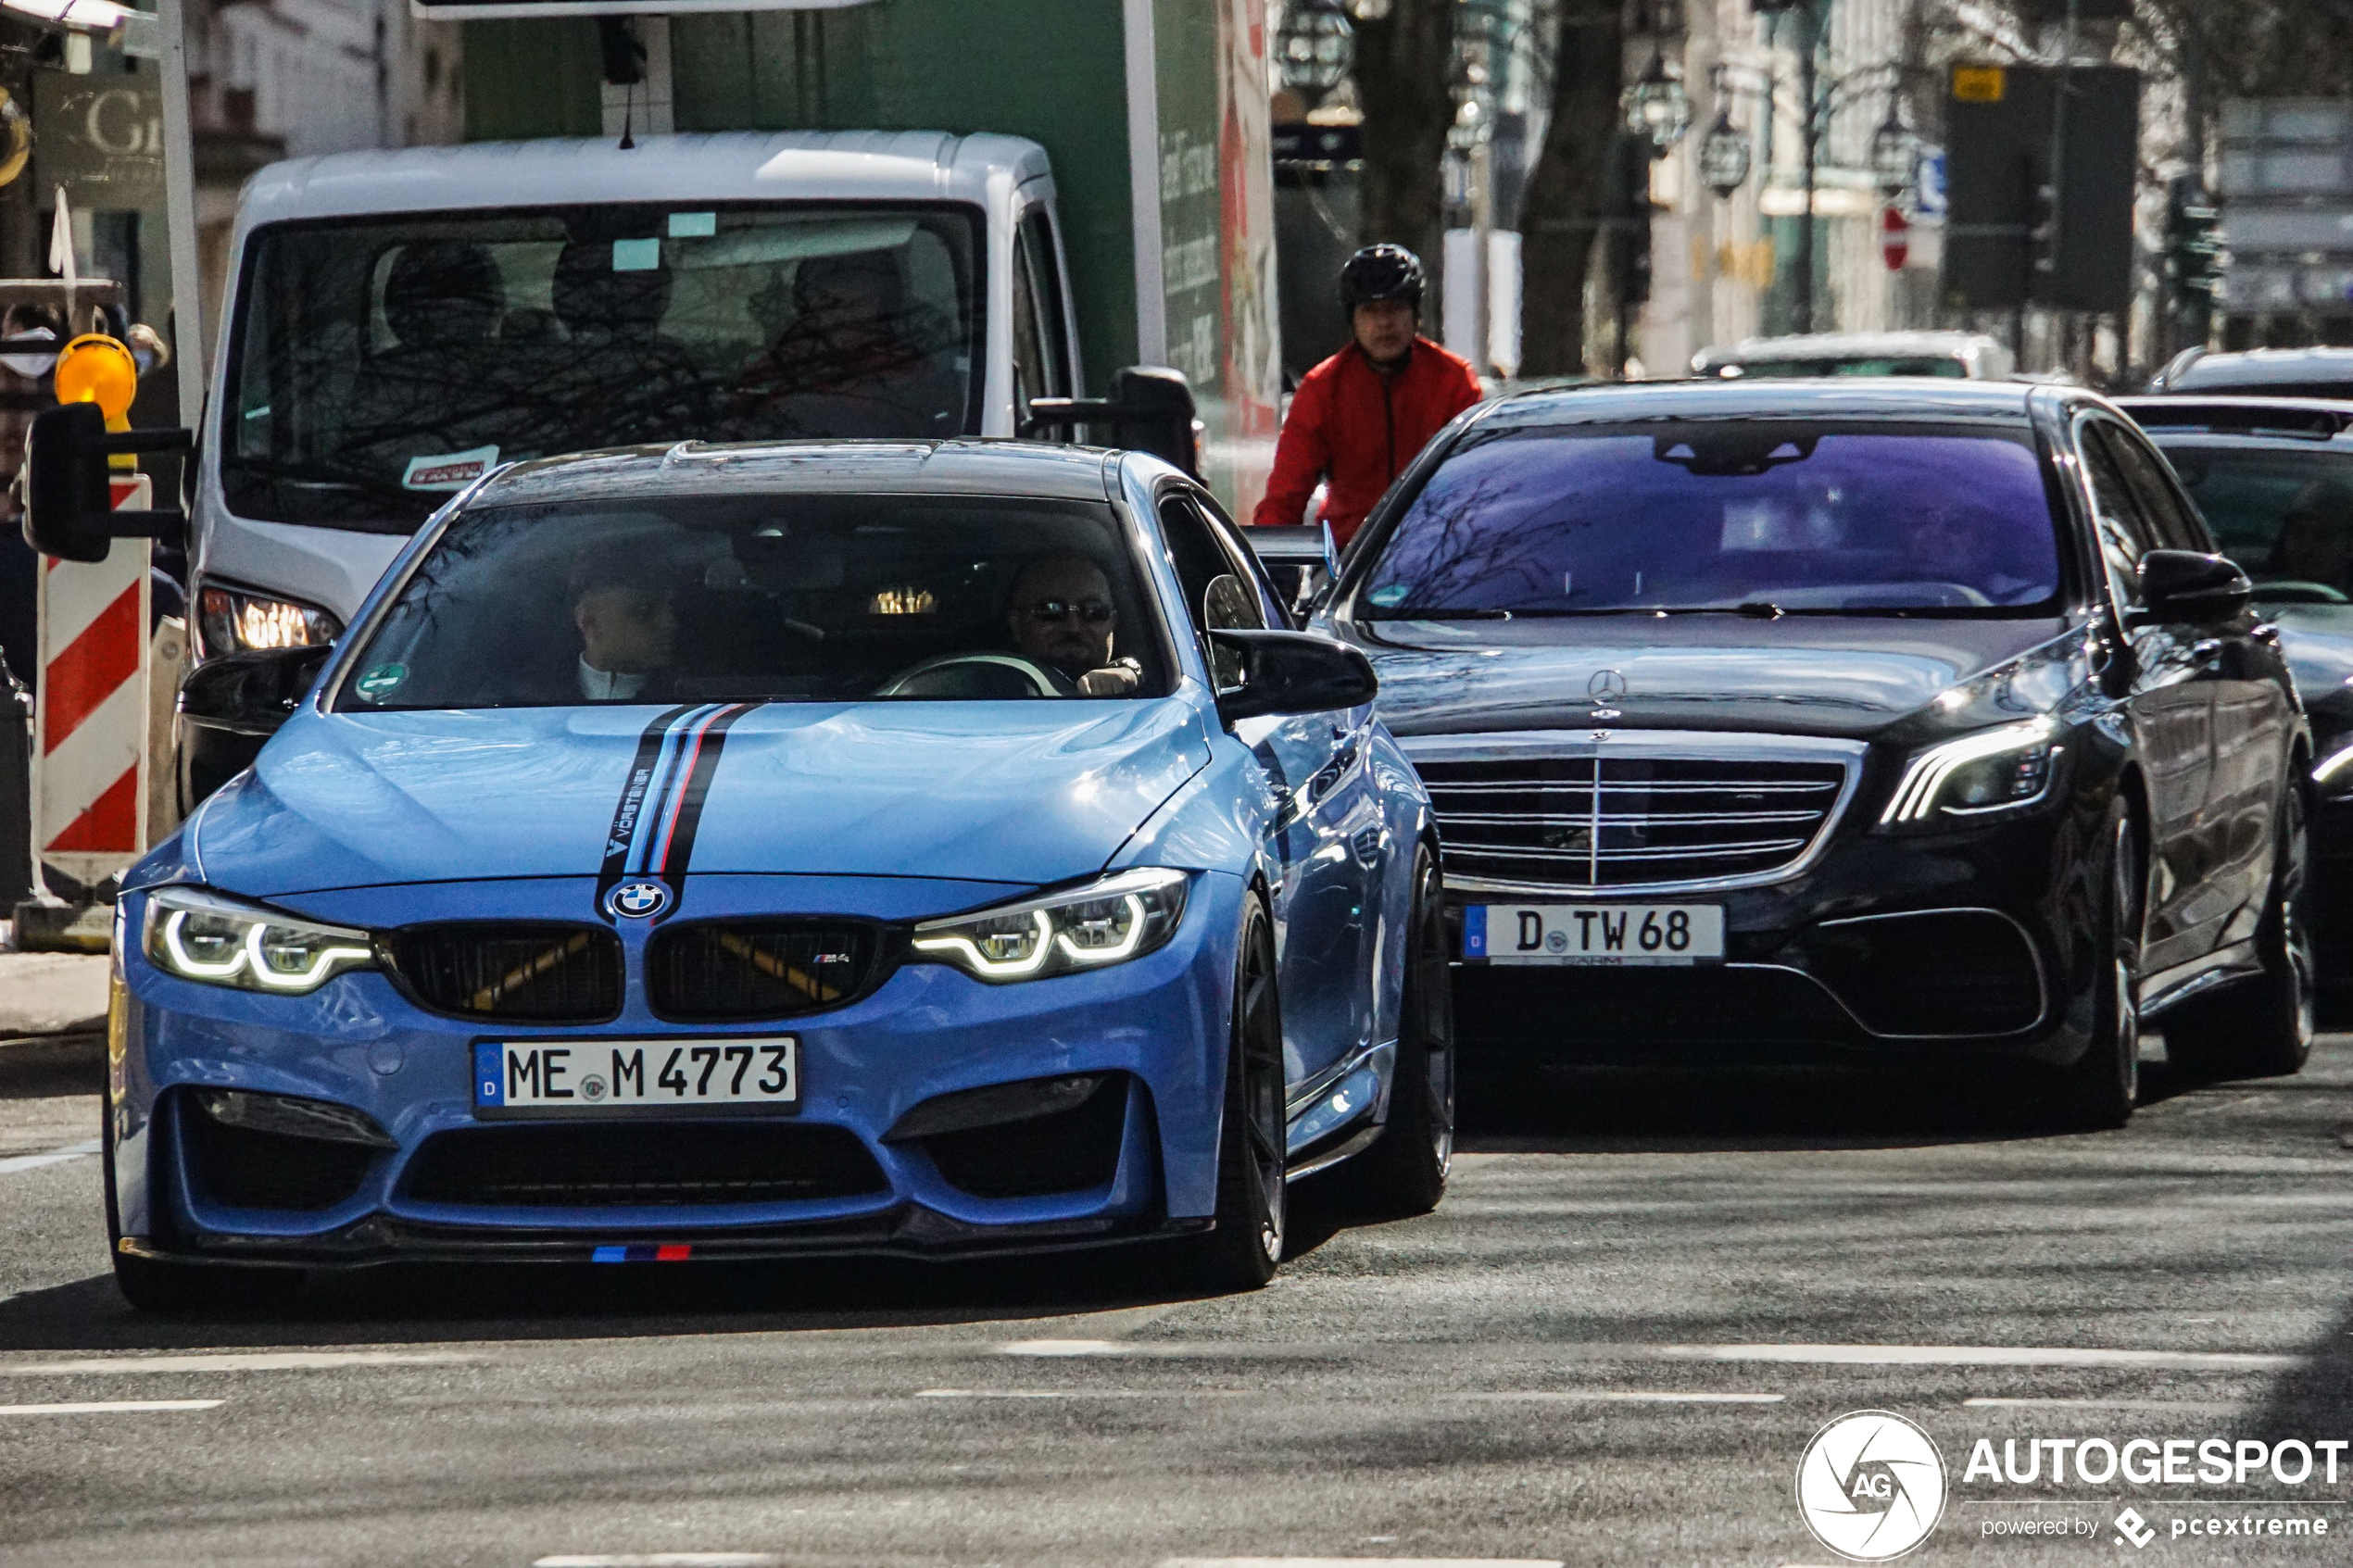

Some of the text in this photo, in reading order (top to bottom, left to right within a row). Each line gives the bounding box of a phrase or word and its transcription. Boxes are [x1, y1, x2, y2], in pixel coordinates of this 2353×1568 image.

[620, 883, 662, 895] BMW
[1516, 909, 1691, 952] D TW 68
[823, 953, 849, 963] M4
[508, 1045, 788, 1099] ME M 4773
[484, 1081, 496, 1097] D
